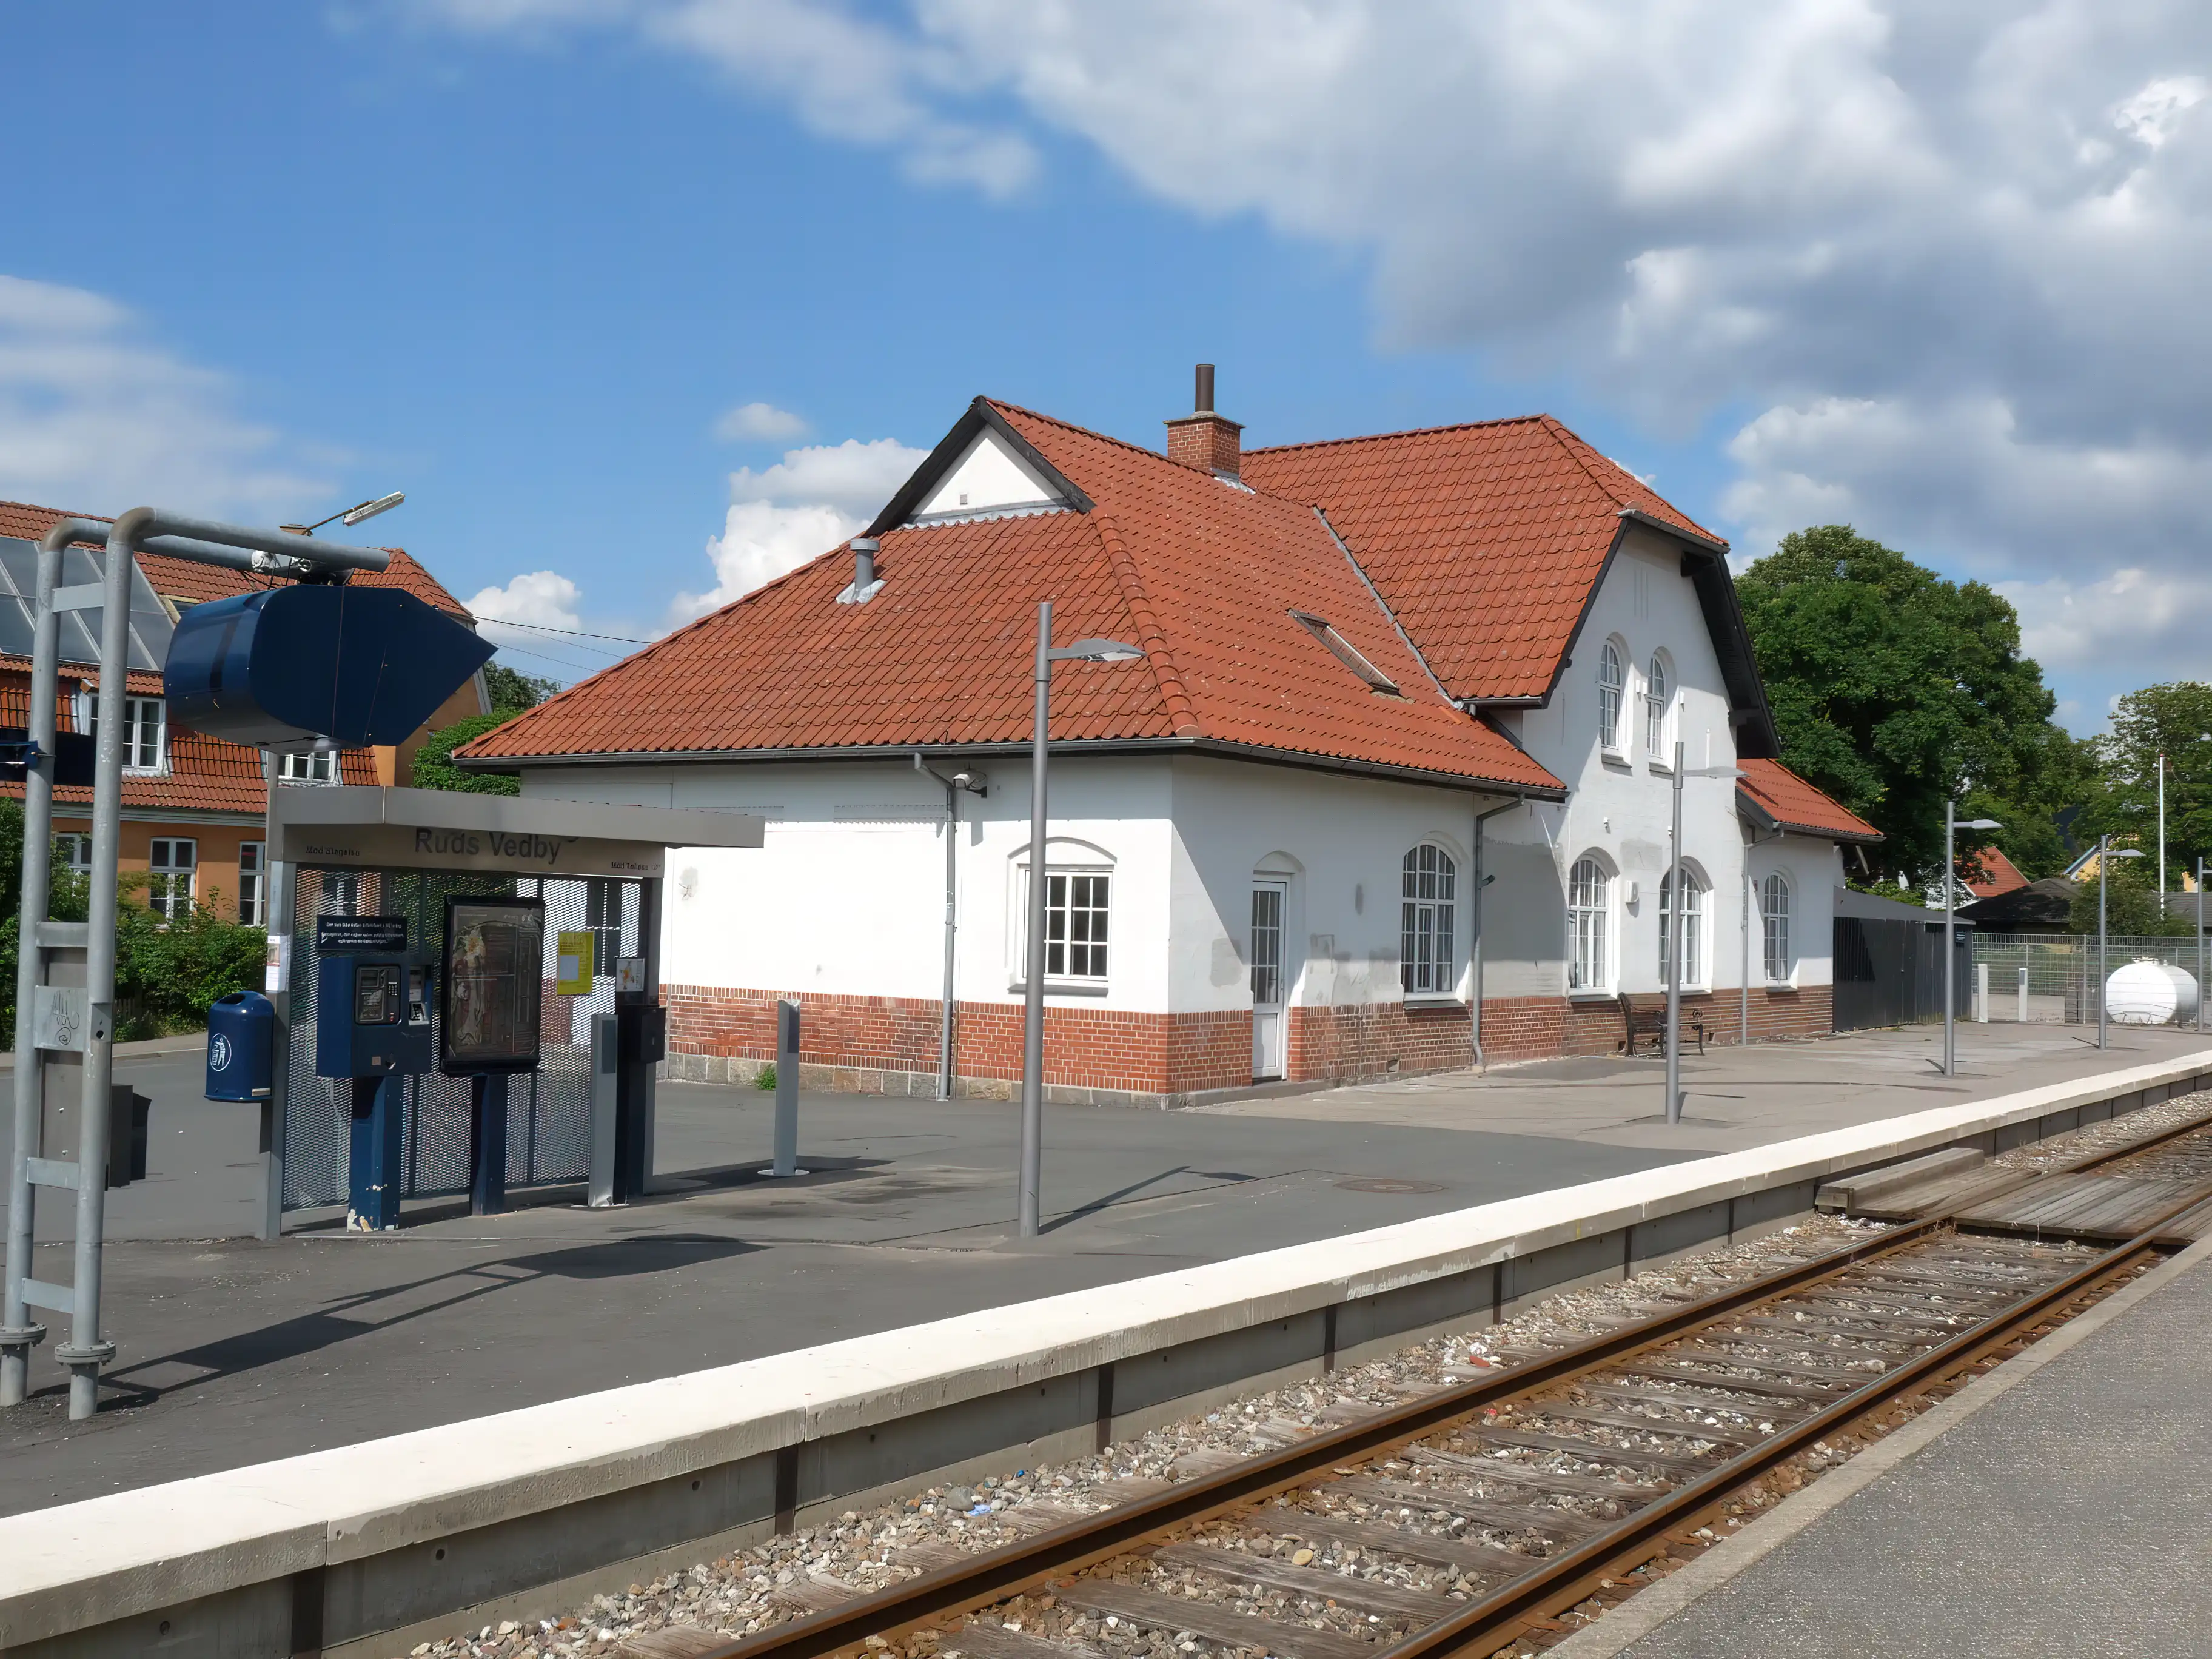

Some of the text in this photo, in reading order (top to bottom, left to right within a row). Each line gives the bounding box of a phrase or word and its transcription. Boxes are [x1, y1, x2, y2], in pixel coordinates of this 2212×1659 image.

[306, 845, 323, 854] Mod
[414, 827, 561, 865] Ruds Vedby
